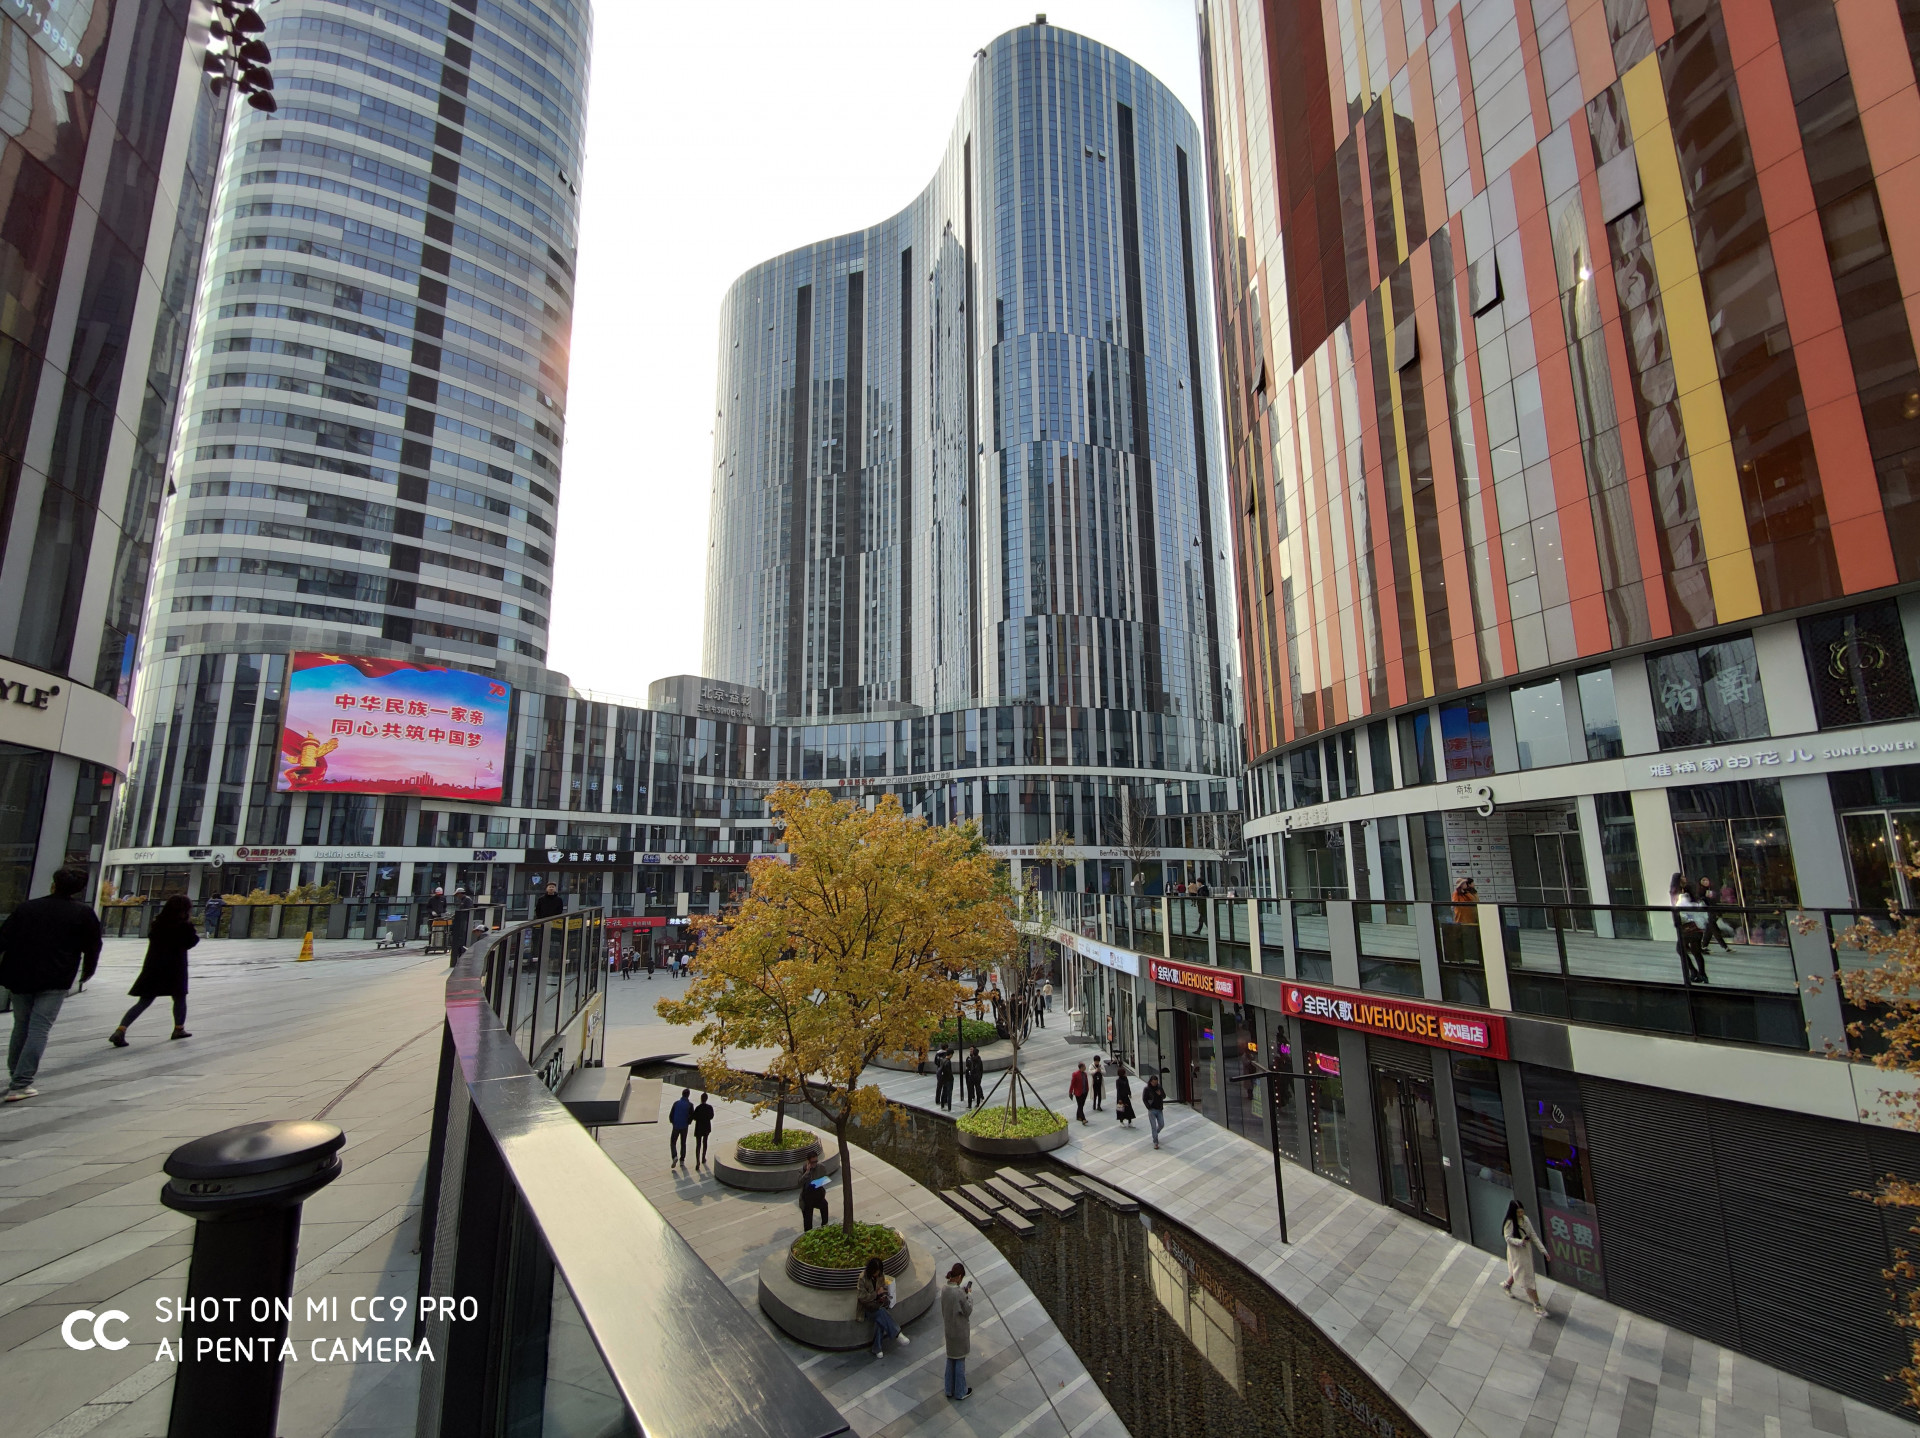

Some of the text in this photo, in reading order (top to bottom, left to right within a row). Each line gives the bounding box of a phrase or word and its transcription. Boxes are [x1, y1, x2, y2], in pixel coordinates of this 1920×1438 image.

[334, 693, 484, 726] 中华民族一家亲
[331, 718, 483, 748] 同心共筑中国梦
[1822, 740, 1917, 759] SUNFLOWER
[1456, 784, 1472, 795] 商场
[1477, 786, 1494, 817] 3
[315, 851, 342, 859] luckin
[345, 851, 373, 859] coffee
[569, 852, 617, 863] 猫屎咖啡
[1179, 970, 1214, 992] LIVEHOUSE
[1303, 994, 1484, 1043] 全民K歌 LIVEHOUSE 欢唱店
[1550, 1215, 1594, 1249] 免费
[1551, 1238, 1600, 1273] WIFI
